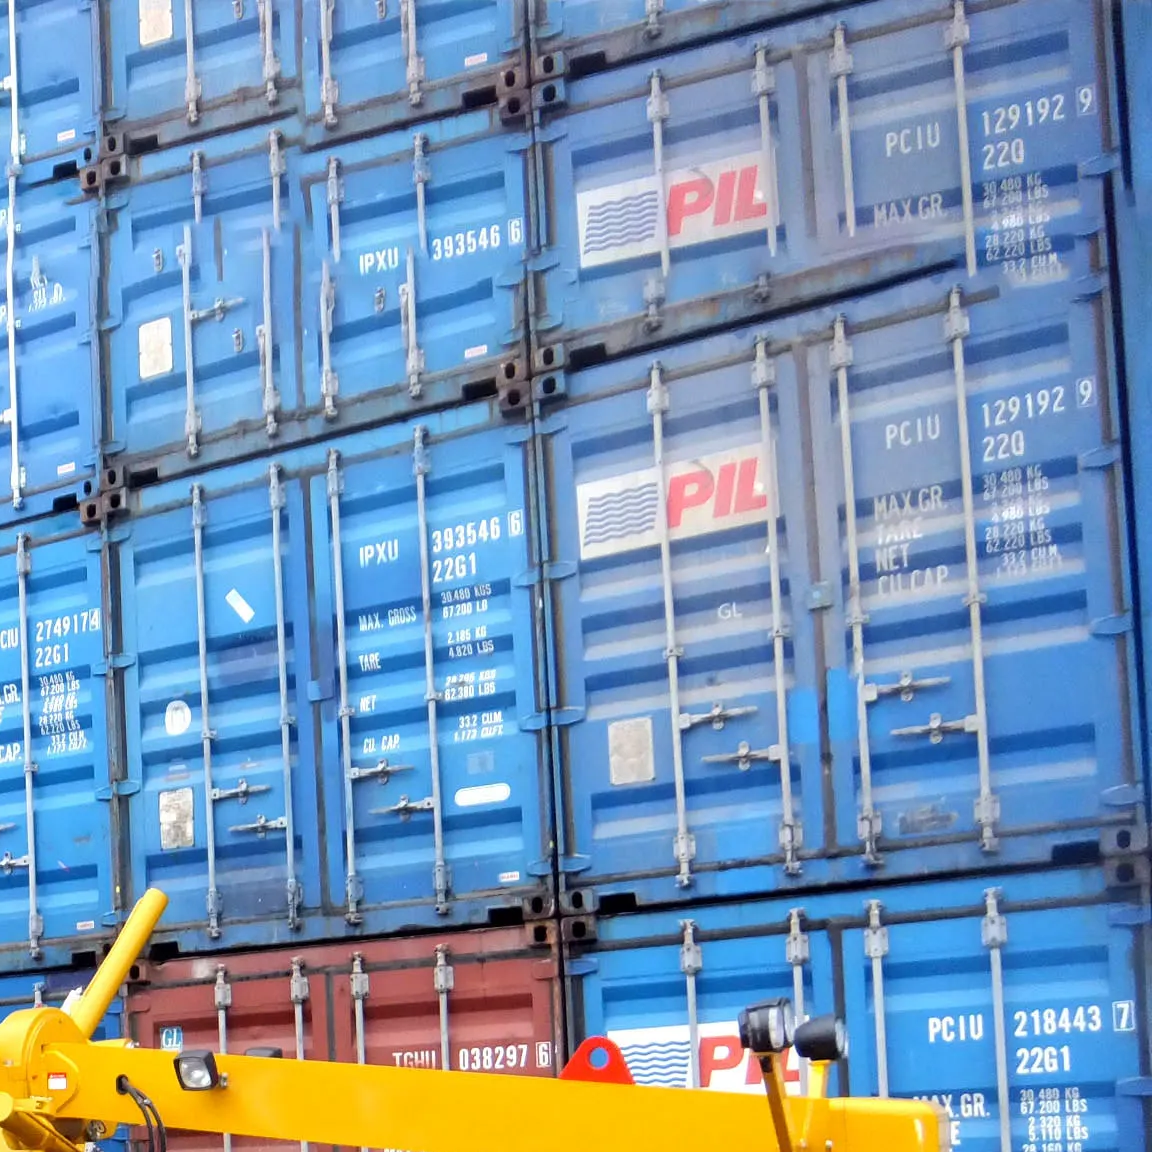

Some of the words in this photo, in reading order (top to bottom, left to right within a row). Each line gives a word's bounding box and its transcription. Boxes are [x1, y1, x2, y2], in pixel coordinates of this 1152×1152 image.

[886, 122, 940, 158] PCIU
[982, 94, 1065, 137] 129192
[1078, 87, 1094, 114] 9
[667, 165, 767, 237] PIL
[359, 247, 398, 275] IPXU
[432, 225, 500, 260] 393546
[509, 219, 522, 243] 6
[886, 414, 940, 449] PCIU
[982, 386, 1065, 428] 129192
[1078, 378, 1094, 405] 9
[667, 457, 767, 529] PIL
[359, 539, 398, 568] IPXU
[432, 517, 500, 552] 393546
[509, 510, 522, 535] 6
[432, 552, 476, 583] 22G1
[875, 543, 908, 571] NET
[359, 613, 384, 631] MAX.
[388, 606, 416, 626] GROSS
[717, 602, 743, 620] GL
[35, 642, 69, 668] 22G1
[477, 639, 494, 653] LBS
[359, 652, 381, 672] TARE
[67, 679, 80, 691] LBS
[478, 682, 495, 697] LBS
[360, 695, 376, 712] NET
[928, 1014, 983, 1043] PCIU
[1014, 1005, 1101, 1037] 218443
[1115, 1003, 1131, 1029] 7
[162, 1028, 182, 1048] GL
[459, 1044, 527, 1070] 038297
[537, 1043, 550, 1066] 6
[1016, 1045, 1070, 1074] 22G1
[1065, 1087, 1079, 1099] KG
[1065, 1099, 1088, 1112] LBS
[1066, 1115, 1080, 1127] KG
[1066, 1126, 1088, 1140] LBS
